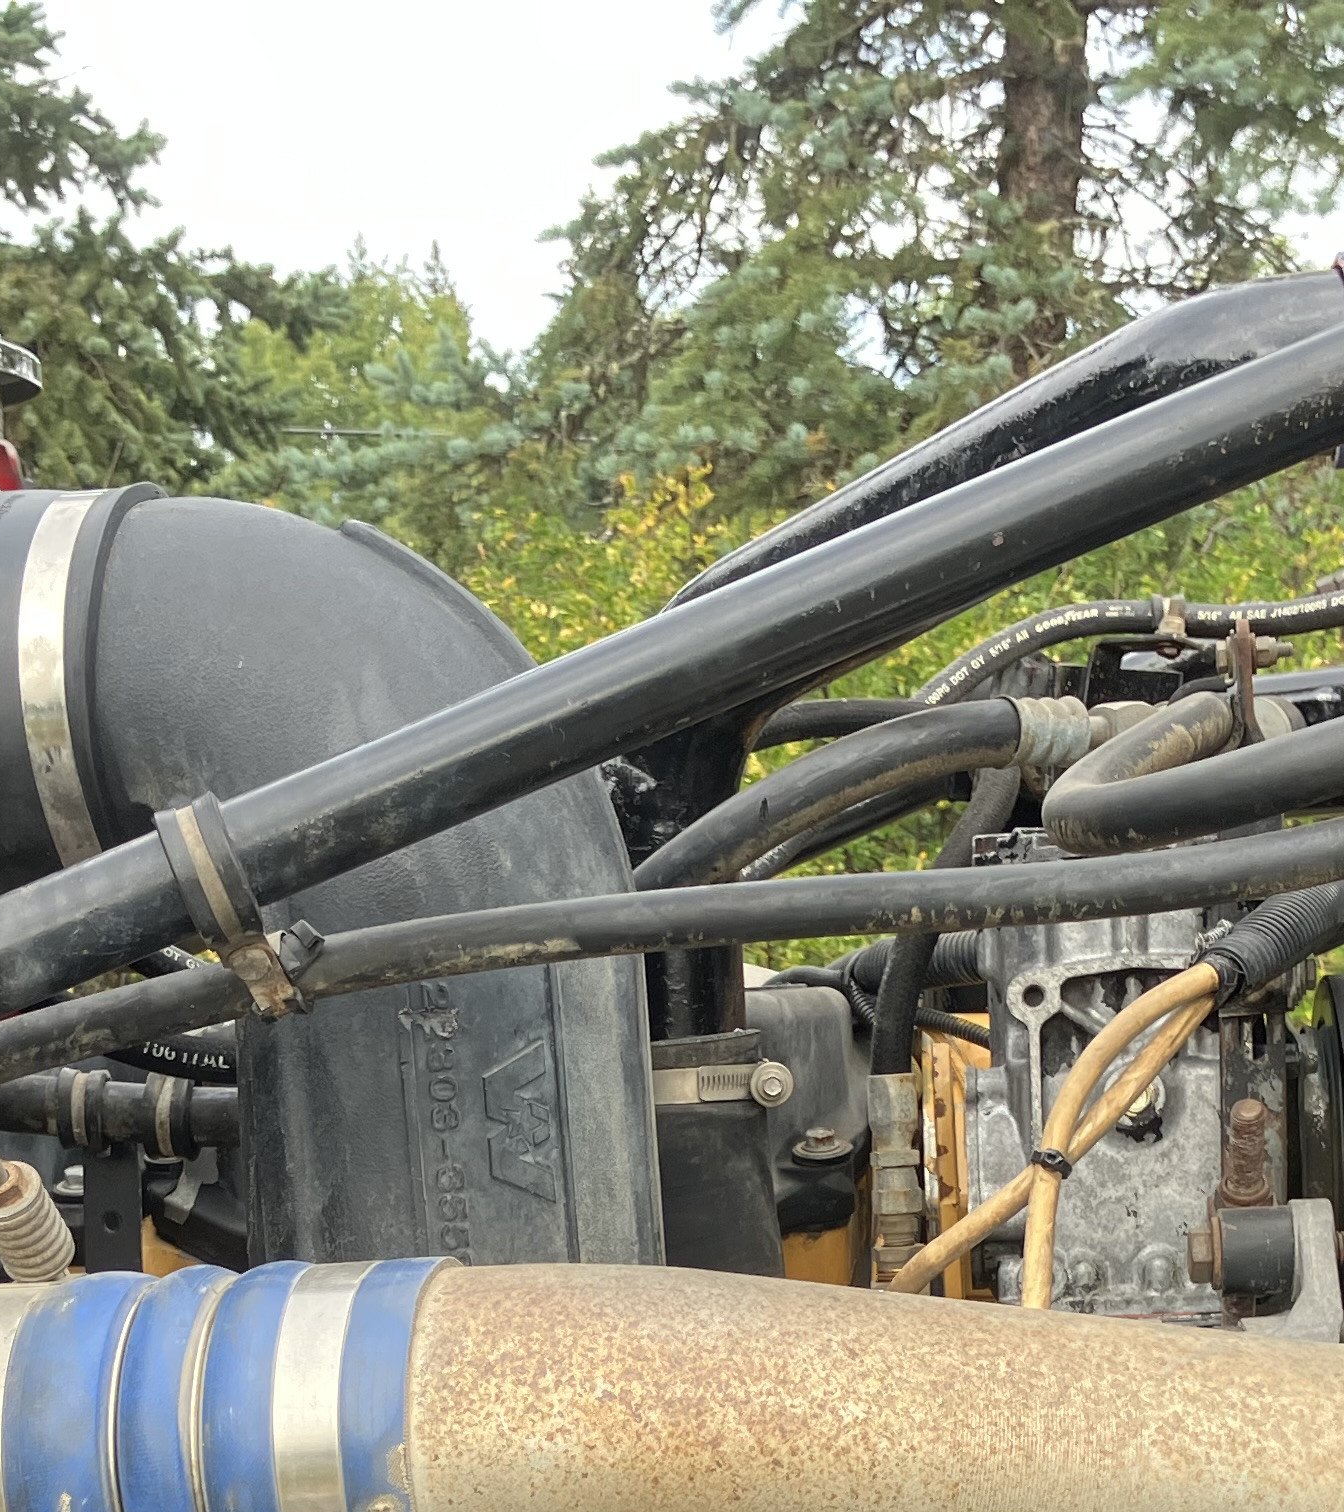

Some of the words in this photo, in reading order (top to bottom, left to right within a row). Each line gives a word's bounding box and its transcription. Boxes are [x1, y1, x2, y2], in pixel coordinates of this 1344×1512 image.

[1245, 608, 1267, 620] SAE
[949, 665, 971, 686] DOT
[970, 654, 987, 670] GY
[1034, 607, 1099, 634] GOODYEAR
